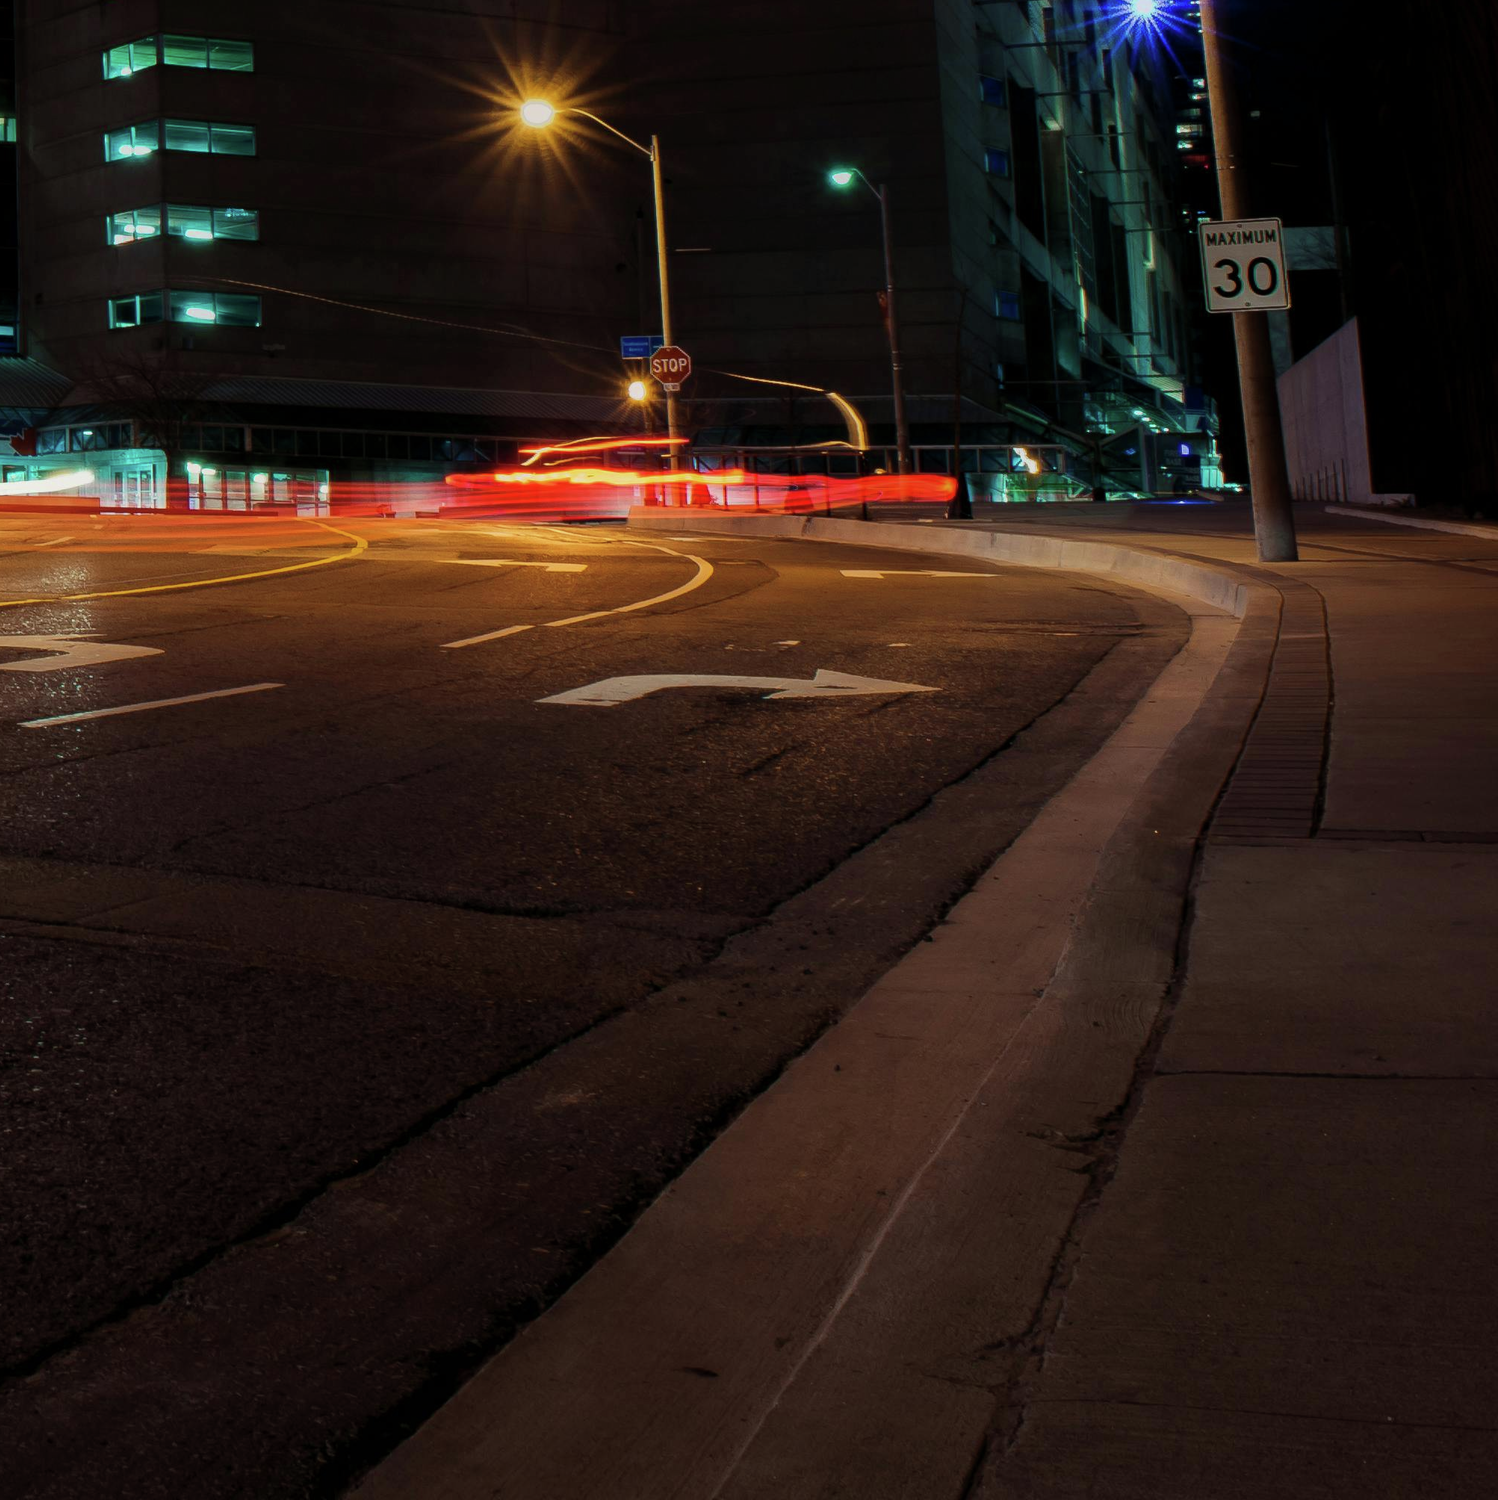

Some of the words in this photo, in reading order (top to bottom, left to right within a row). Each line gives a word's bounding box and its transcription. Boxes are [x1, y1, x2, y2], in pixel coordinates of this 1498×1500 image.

[1205, 230, 1277, 246] MAXIMUM
[1213, 257, 1277, 298] 30
[652, 358, 688, 373] STOP
